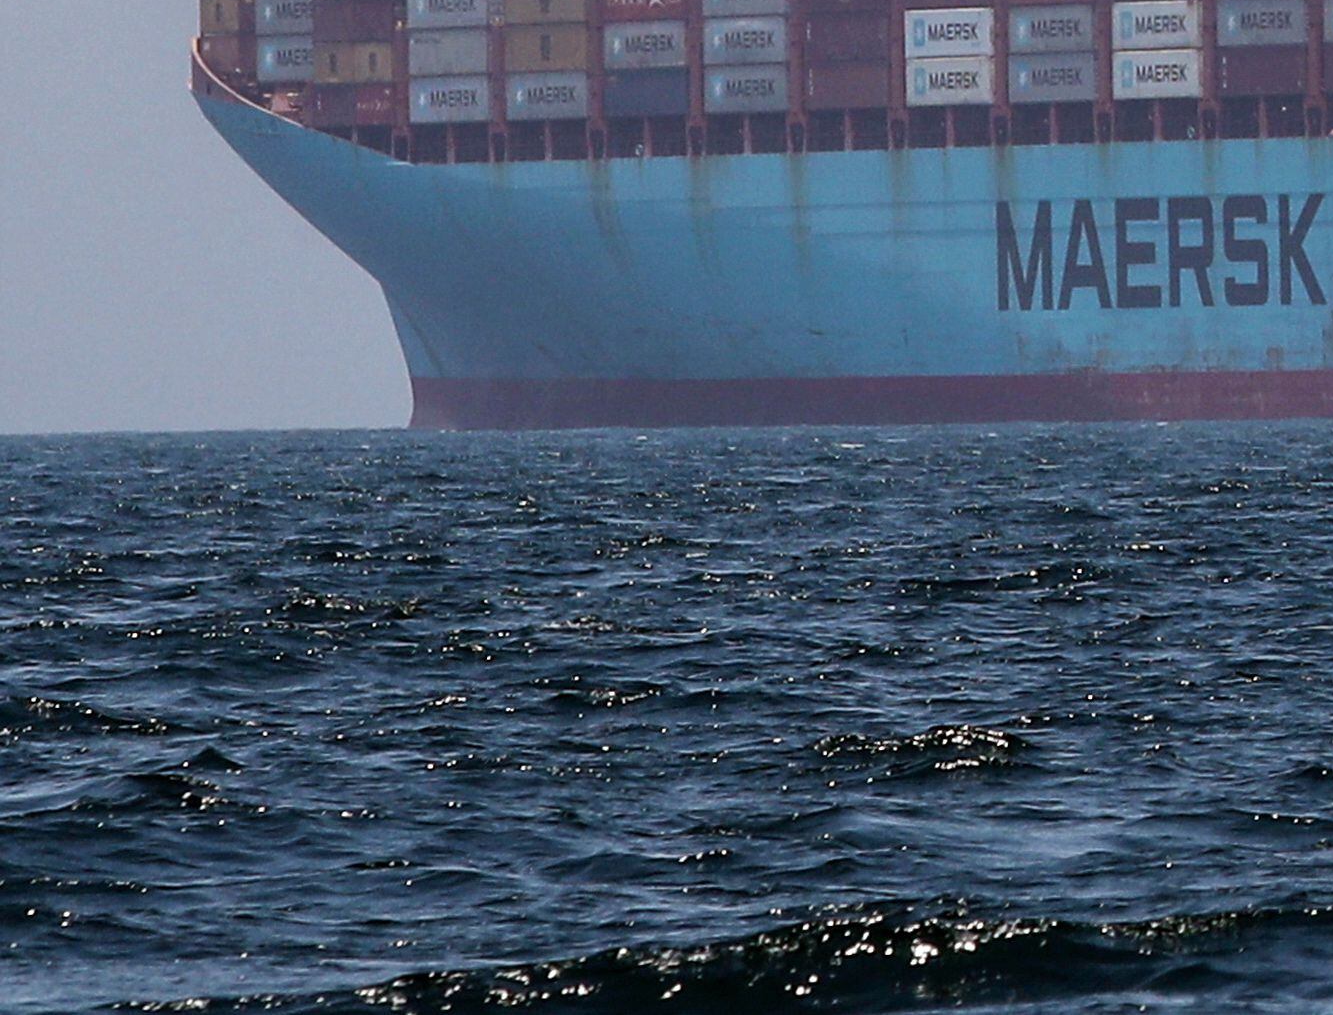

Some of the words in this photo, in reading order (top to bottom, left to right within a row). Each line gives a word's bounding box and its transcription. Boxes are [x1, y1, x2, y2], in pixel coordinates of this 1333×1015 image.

[1031, 19, 1081, 38] MAERSK
[1135, 14, 1186, 33] MAERSK
[1241, 11, 1292, 29] MAERSK
[725, 30, 774, 49] MAERSK
[929, 23, 978, 41] MAERSK
[625, 35, 674, 53] MAERSK
[930, 71, 978, 90] MAERSK
[1032, 67, 1082, 85] MAERSK
[1136, 64, 1186, 83] MAERSK
[528, 87, 574, 104] MAERSK
[727, 78, 775, 97] MAERSK
[430, 90, 477, 108] MAERSK
[996, 193, 1327, 310] MAERSK
